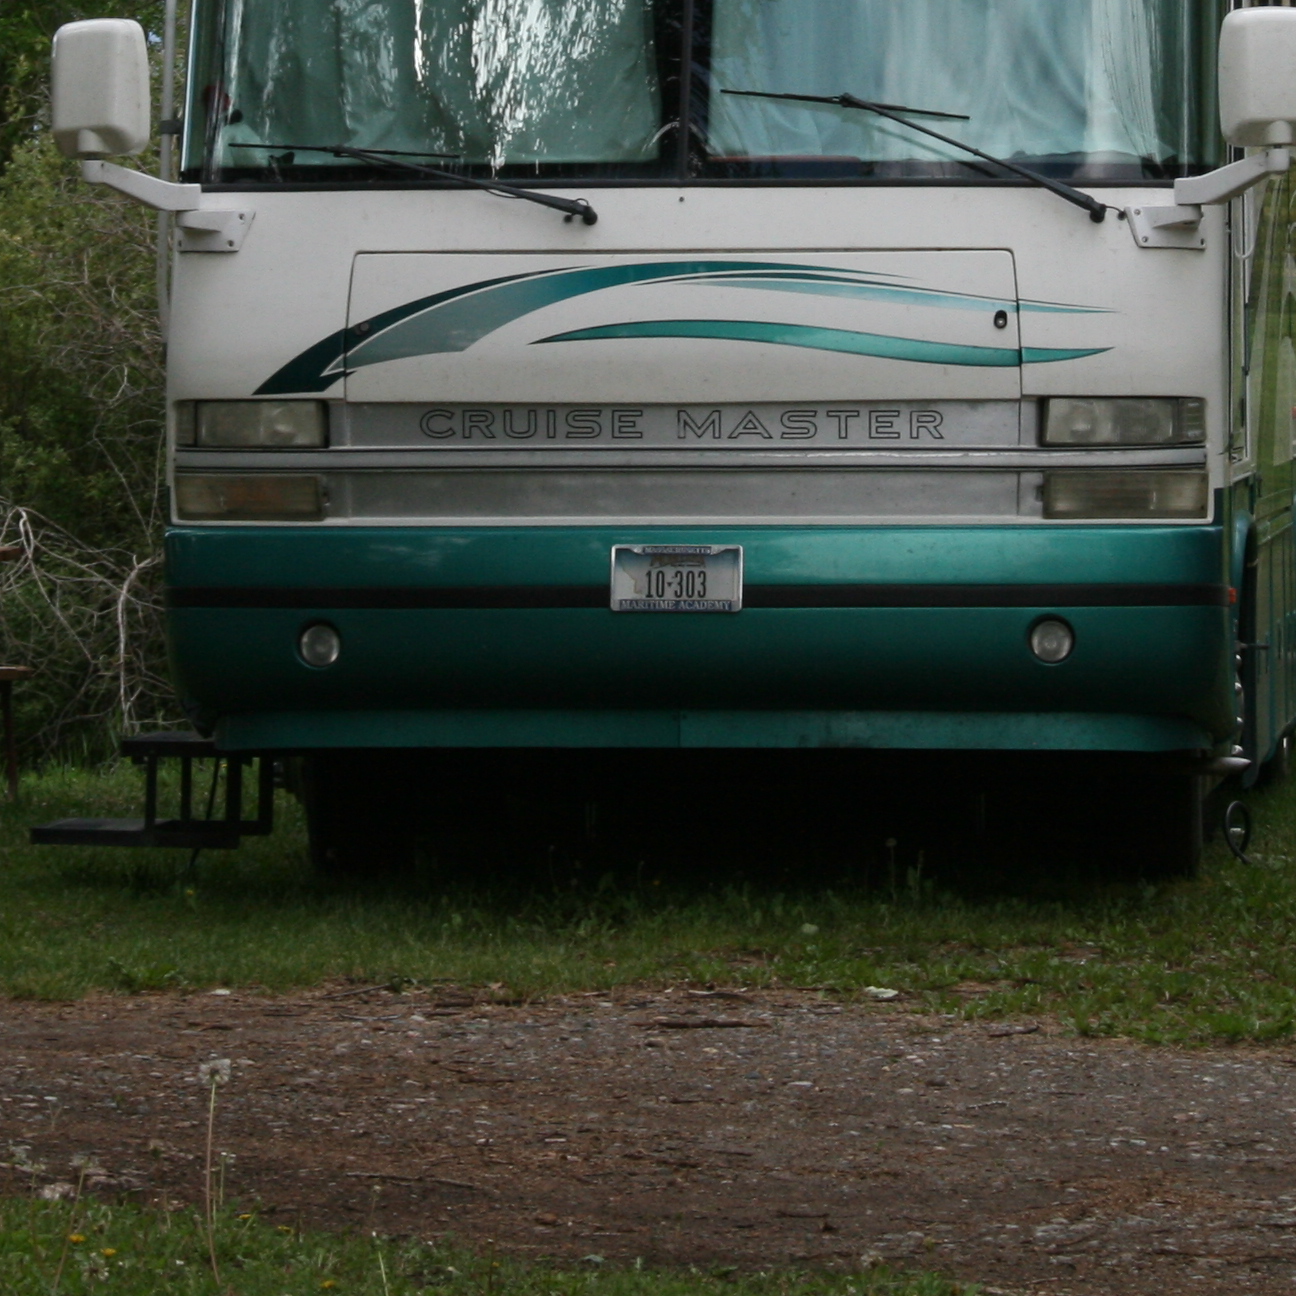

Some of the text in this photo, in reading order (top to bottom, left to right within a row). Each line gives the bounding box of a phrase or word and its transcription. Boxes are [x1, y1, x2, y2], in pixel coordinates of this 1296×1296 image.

[419, 408, 945, 440] CRUISE MASTER
[621, 600, 731, 611] MARITIME ACADEMY
